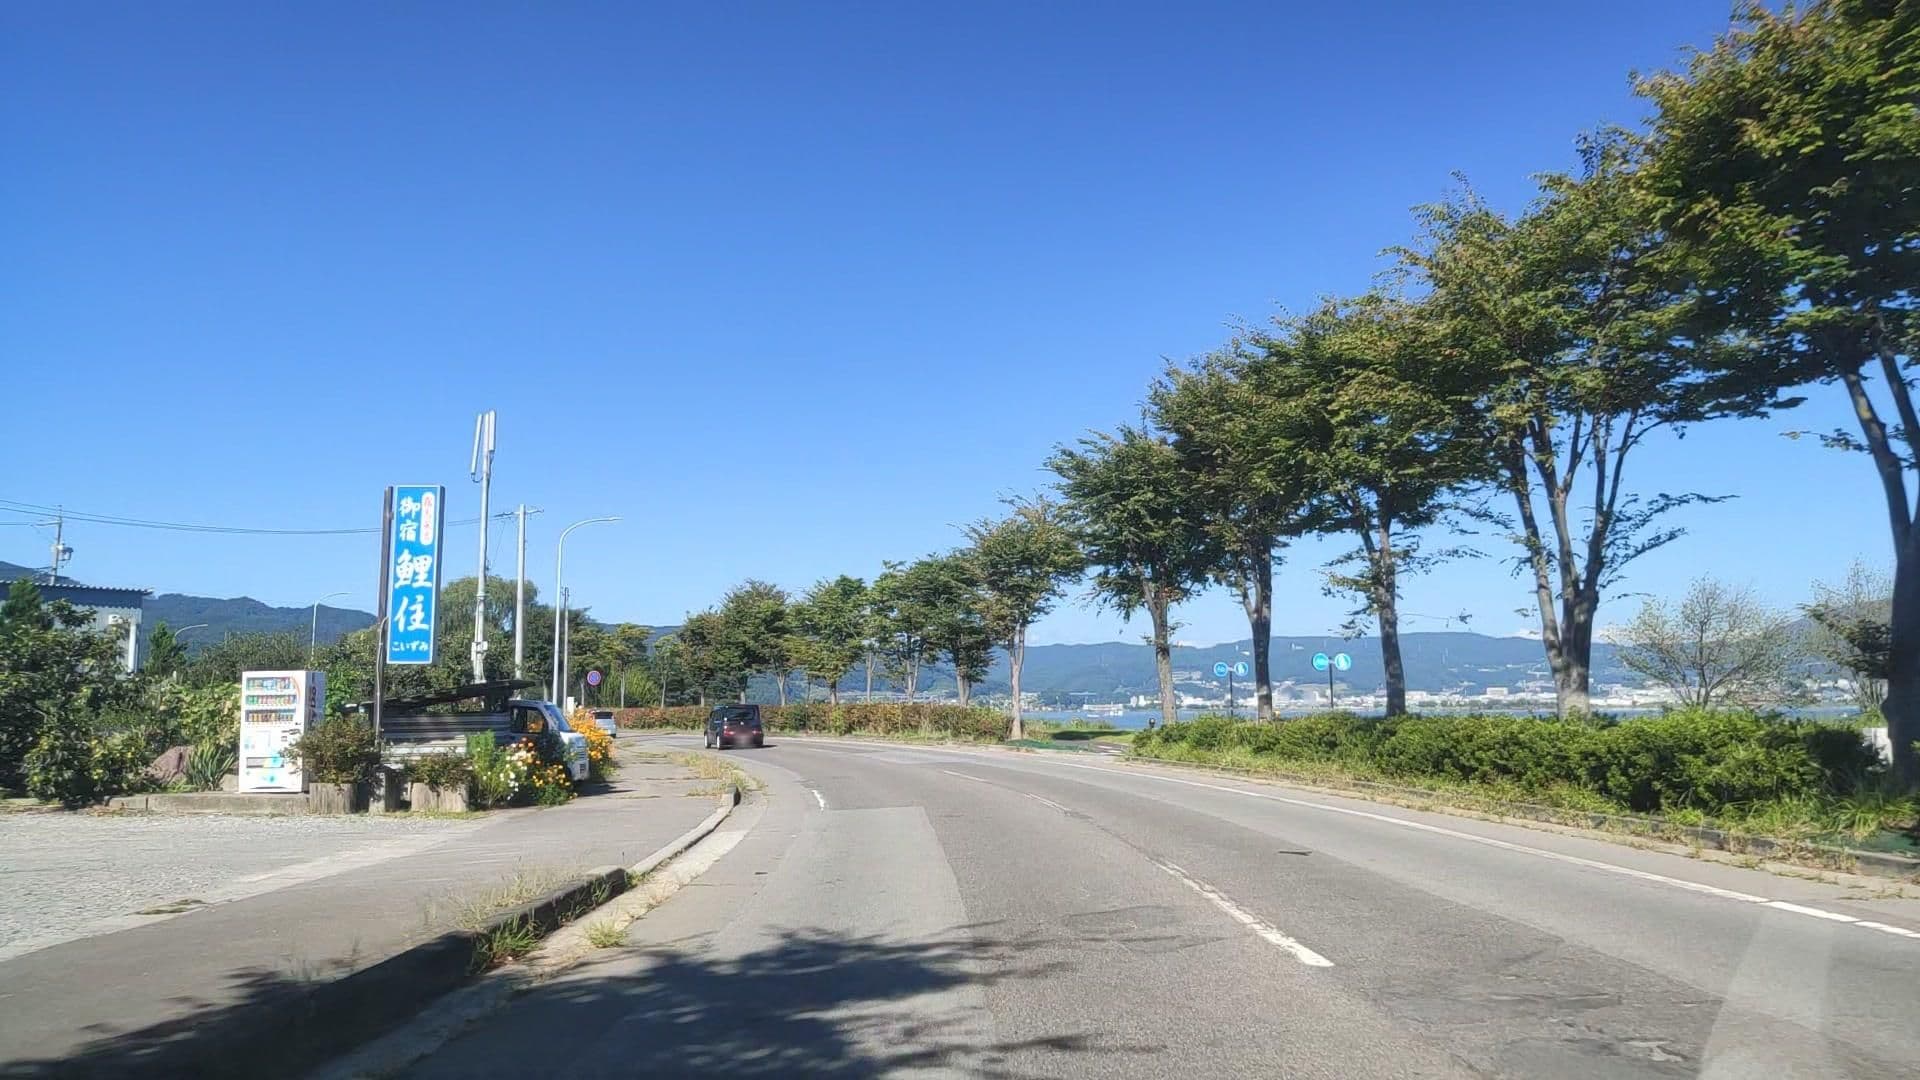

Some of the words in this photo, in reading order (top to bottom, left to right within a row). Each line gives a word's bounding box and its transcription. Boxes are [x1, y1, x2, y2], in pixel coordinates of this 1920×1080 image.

[399, 496, 420, 542] 御宿
[394, 549, 433, 633] 鯉住
[391, 641, 428, 652] こいずみ
